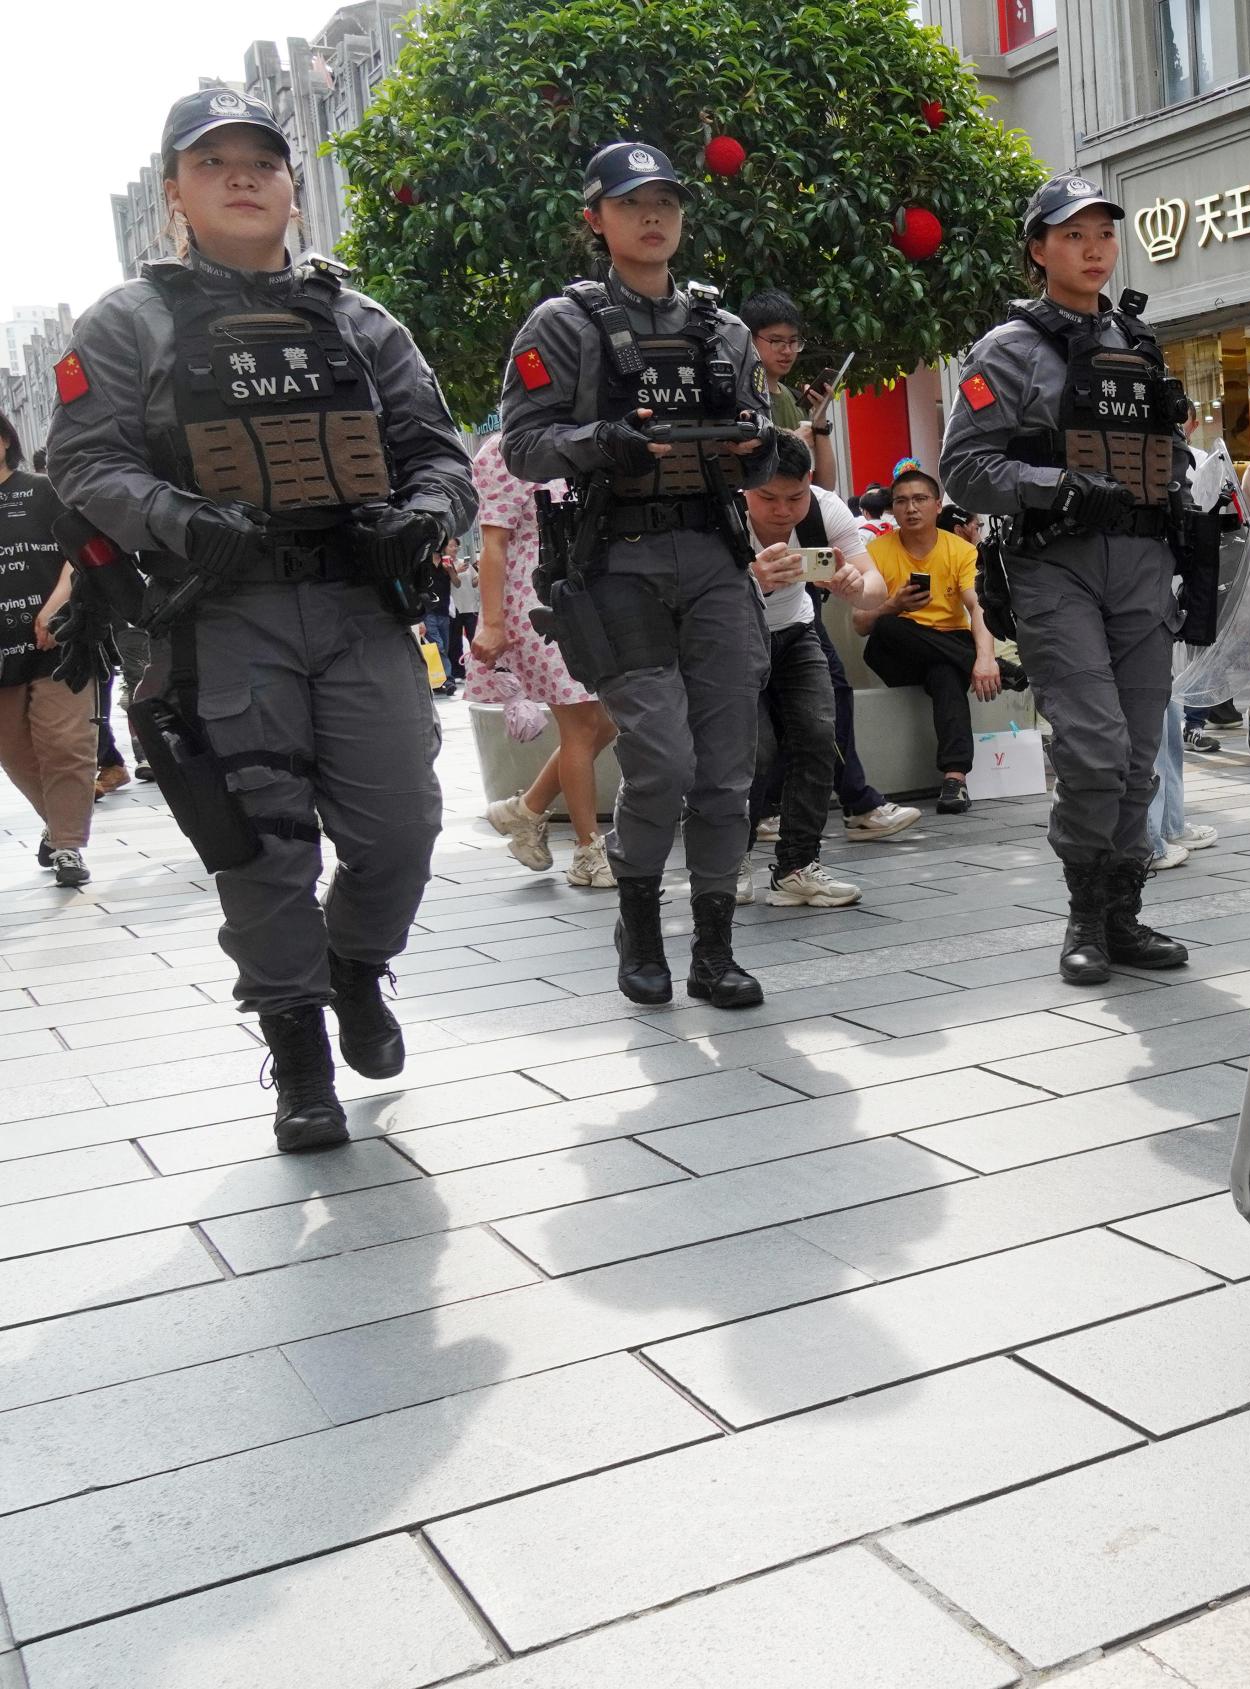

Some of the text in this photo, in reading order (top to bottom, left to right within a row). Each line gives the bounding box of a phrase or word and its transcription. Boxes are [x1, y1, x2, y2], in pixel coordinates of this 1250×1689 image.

[229, 347, 309, 375] 特警
[641, 366, 696, 385] 特警
[231, 373, 320, 399] SWAT
[1101, 380, 1146, 400] 特警
[637, 388, 702, 403] SWAT
[1099, 400, 1150, 418] SWAT
[11, 487, 34, 498] and
[15, 542, 23, 552] if
[31, 542, 59, 552] want
[28, 594, 42, 605] till
